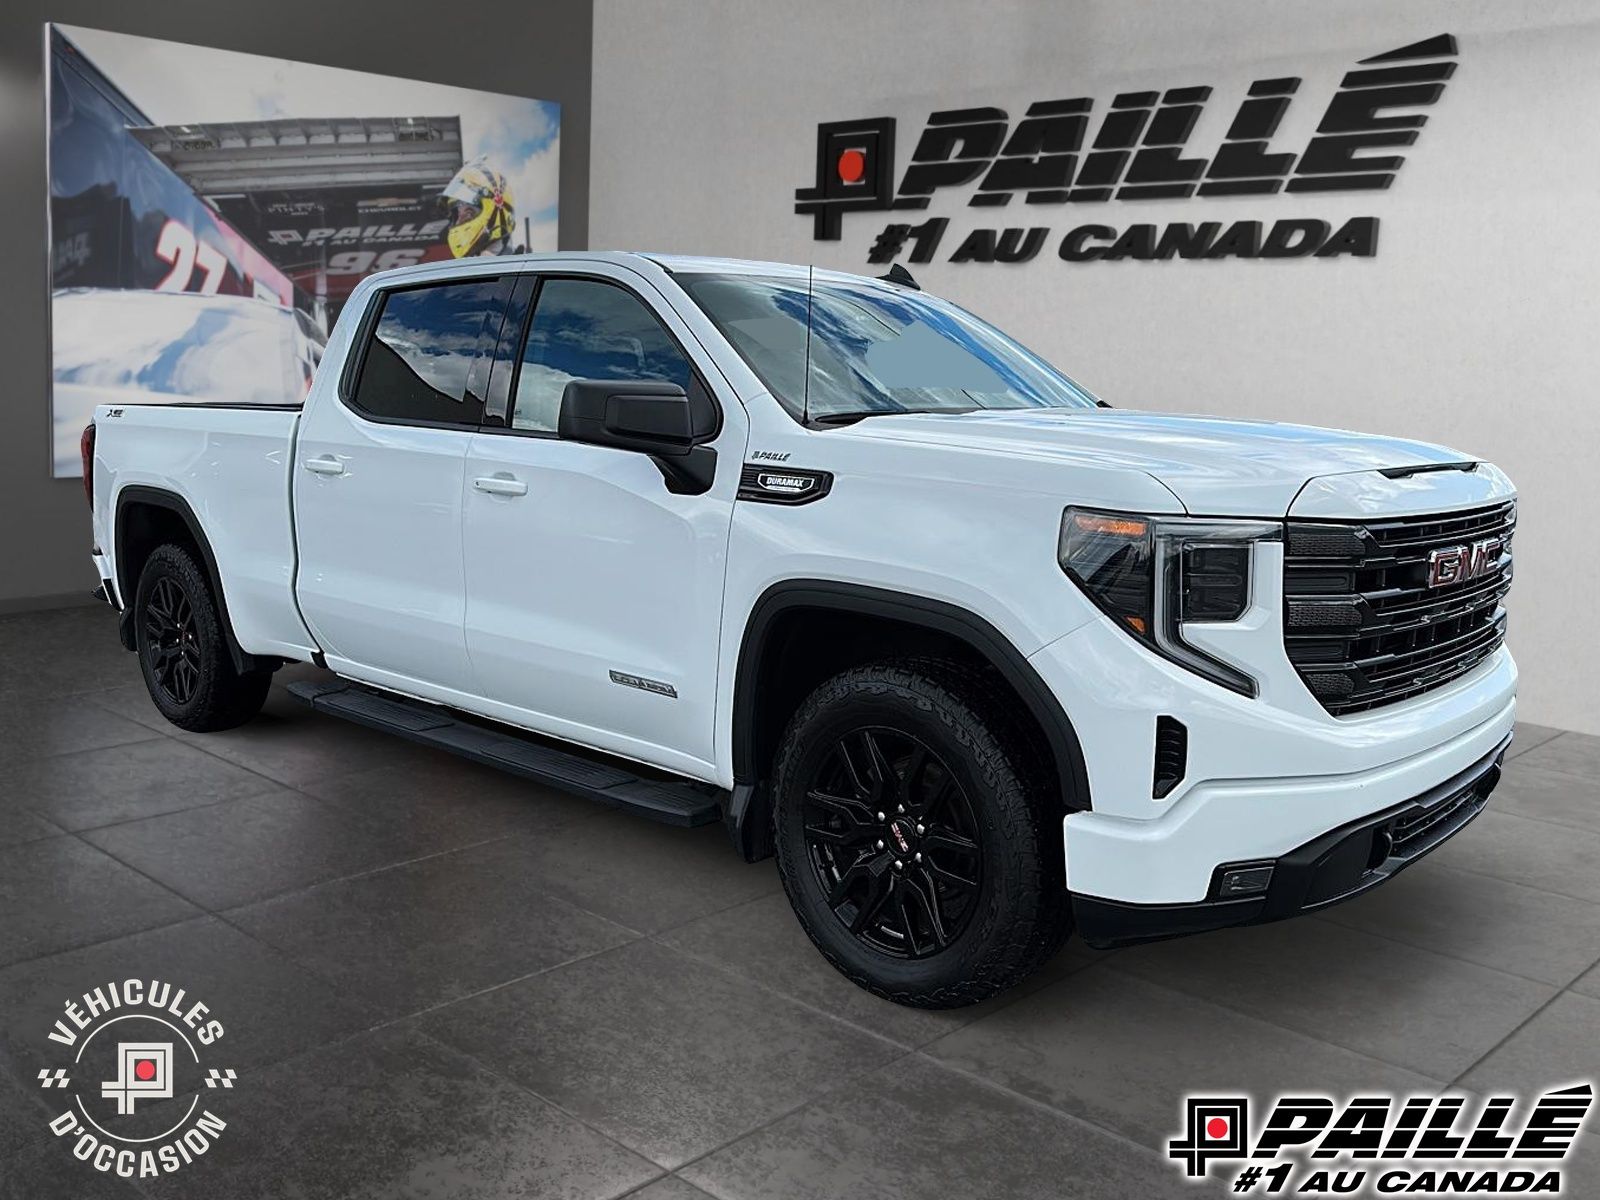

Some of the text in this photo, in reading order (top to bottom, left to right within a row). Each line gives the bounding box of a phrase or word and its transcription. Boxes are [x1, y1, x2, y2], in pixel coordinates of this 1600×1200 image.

[893, 33, 1458, 210] PAILLÉ
[329, 238, 358, 246] AU
[362, 235, 440, 243] CANADA
[867, 217, 1380, 263] #1 AU CANADA
[1428, 538, 1501, 589] GMC
